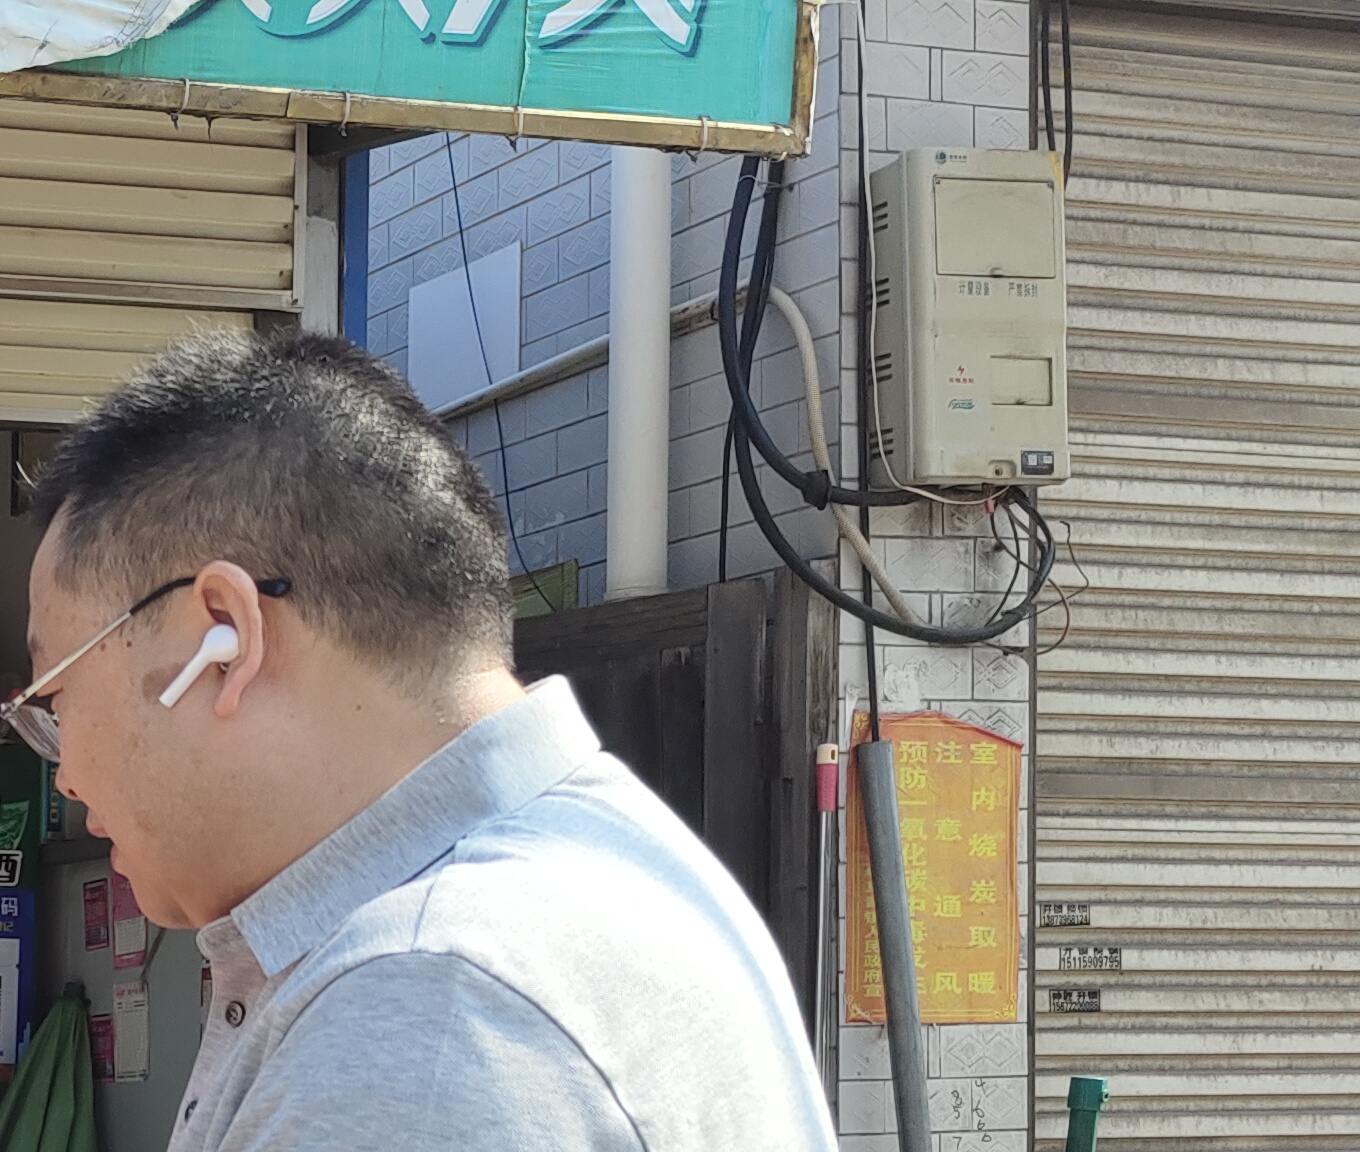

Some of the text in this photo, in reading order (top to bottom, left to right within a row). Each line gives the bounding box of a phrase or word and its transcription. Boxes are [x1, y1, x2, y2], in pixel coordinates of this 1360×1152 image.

[933, 742, 963, 994] 注意通风
[968, 742, 998, 994] 室内烧炭取暖
